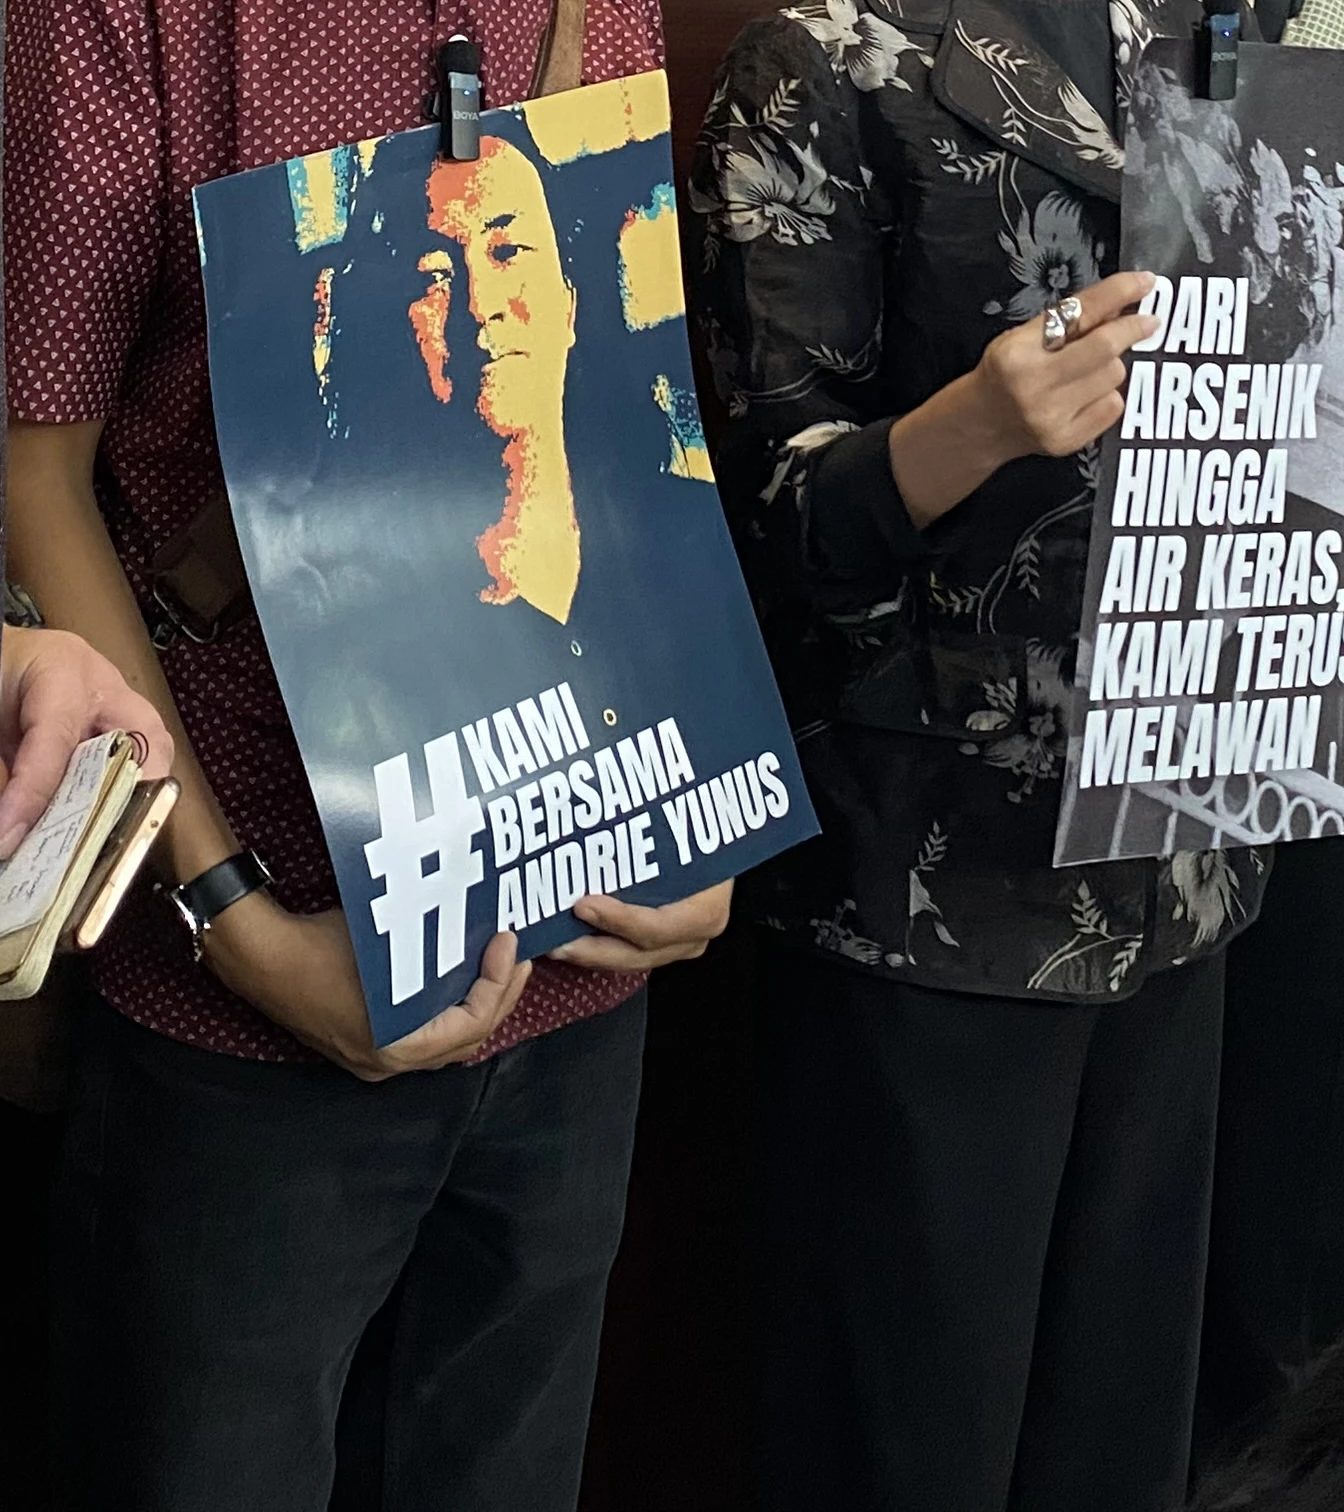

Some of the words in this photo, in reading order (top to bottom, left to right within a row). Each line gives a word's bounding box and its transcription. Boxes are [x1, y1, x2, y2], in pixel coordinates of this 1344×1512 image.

[453, 110, 479, 121] BOYA
[1131, 275, 1249, 356] DARI
[1121, 360, 1323, 441] ARSENIK
[1111, 448, 1288, 527] HINGGA
[1099, 535, 1187, 614] AIR
[1089, 619, 1224, 701] KAMI
[462, 681, 590, 793] KAMI
[1079, 695, 1322, 789] MELAWAN
[487, 717, 695, 869] BERSAMA
[497, 821, 660, 933] ANDRIE
[661, 750, 790, 866] YUNUS
